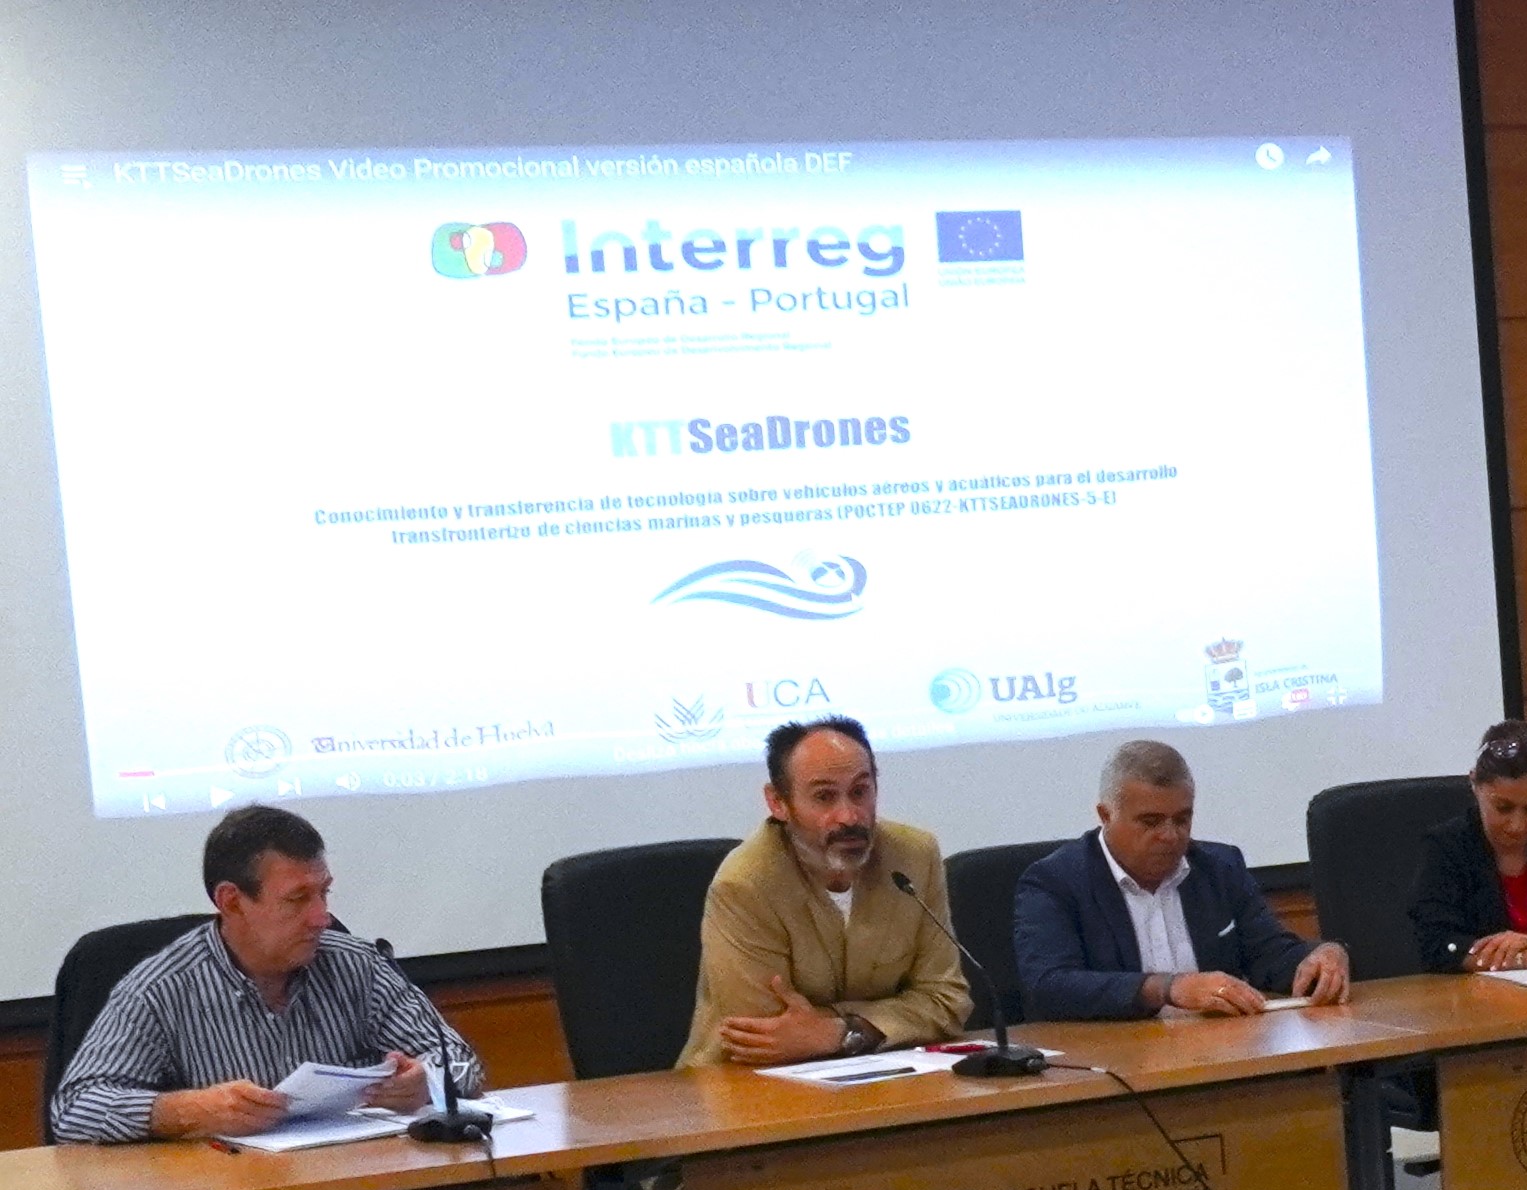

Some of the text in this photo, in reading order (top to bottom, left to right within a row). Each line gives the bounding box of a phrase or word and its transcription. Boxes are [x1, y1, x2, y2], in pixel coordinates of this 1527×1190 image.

[113, 151, 852, 184] KTTSeaDrones Video Promocional versión española DEF
[561, 219, 906, 278] Interreg
[568, 289, 709, 324] España
[750, 283, 910, 321] Portugal
[610, 415, 911, 458] KTTSeaDrones
[315, 505, 448, 525] Conocimiento
[454, 507, 464, 521] y
[468, 497, 595, 519] transferencia
[601, 494, 623, 511] de
[728, 487, 777, 504] sobre
[1035, 471, 1072, 489] para
[1077, 468, 1091, 484] el
[1095, 463, 1178, 484] desarrollo
[392, 525, 531, 545] transfronterizo
[537, 521, 560, 538] de
[564, 516, 642, 536] ciencias
[648, 513, 721, 531] marinas
[740, 507, 834, 528] pesqueras
[744, 677, 831, 709] UCA
[989, 672, 1078, 704] UAlg
[1283, 673, 1338, 690] CRISTINA
[443, 726, 472, 749] de
